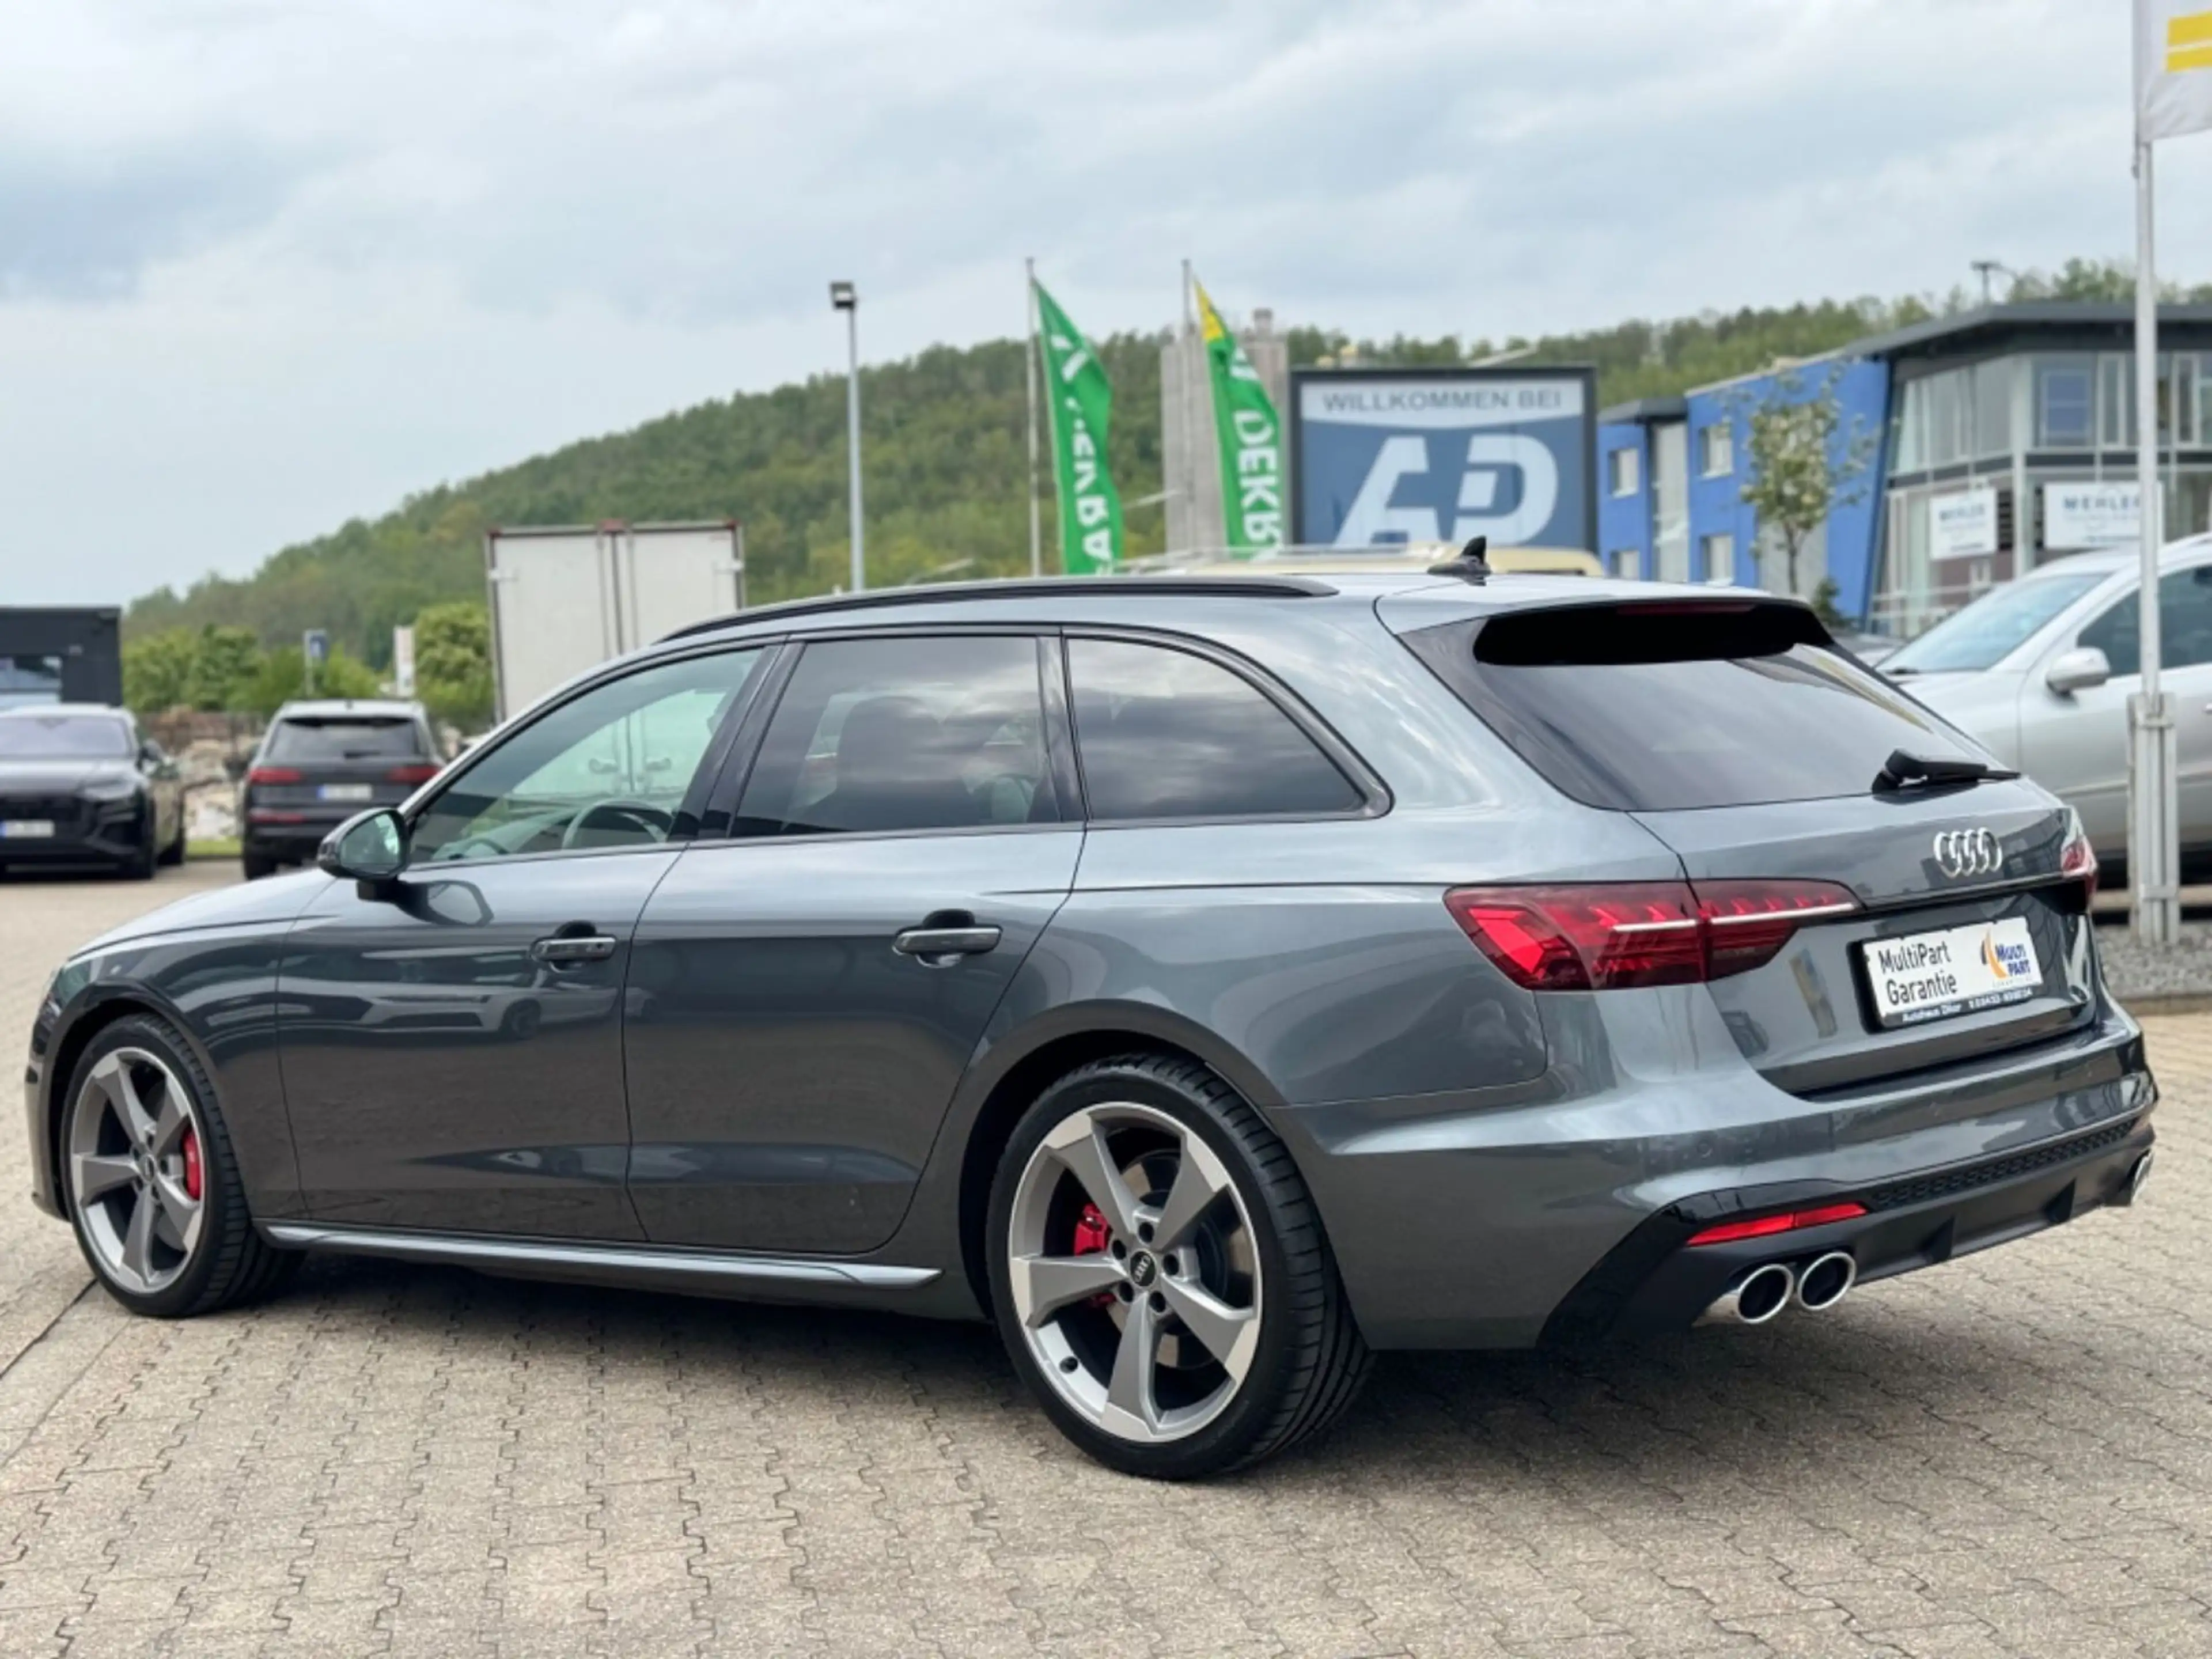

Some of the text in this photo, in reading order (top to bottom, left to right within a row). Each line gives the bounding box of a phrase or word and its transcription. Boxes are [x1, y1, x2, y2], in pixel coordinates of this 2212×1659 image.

[1323, 388, 1561, 412] WILLKOMMEN BEI
[1878, 940, 1952, 975] MultiPart
[2008, 959, 2031, 976] PART
[1886, 968, 1957, 1006] Garantie
